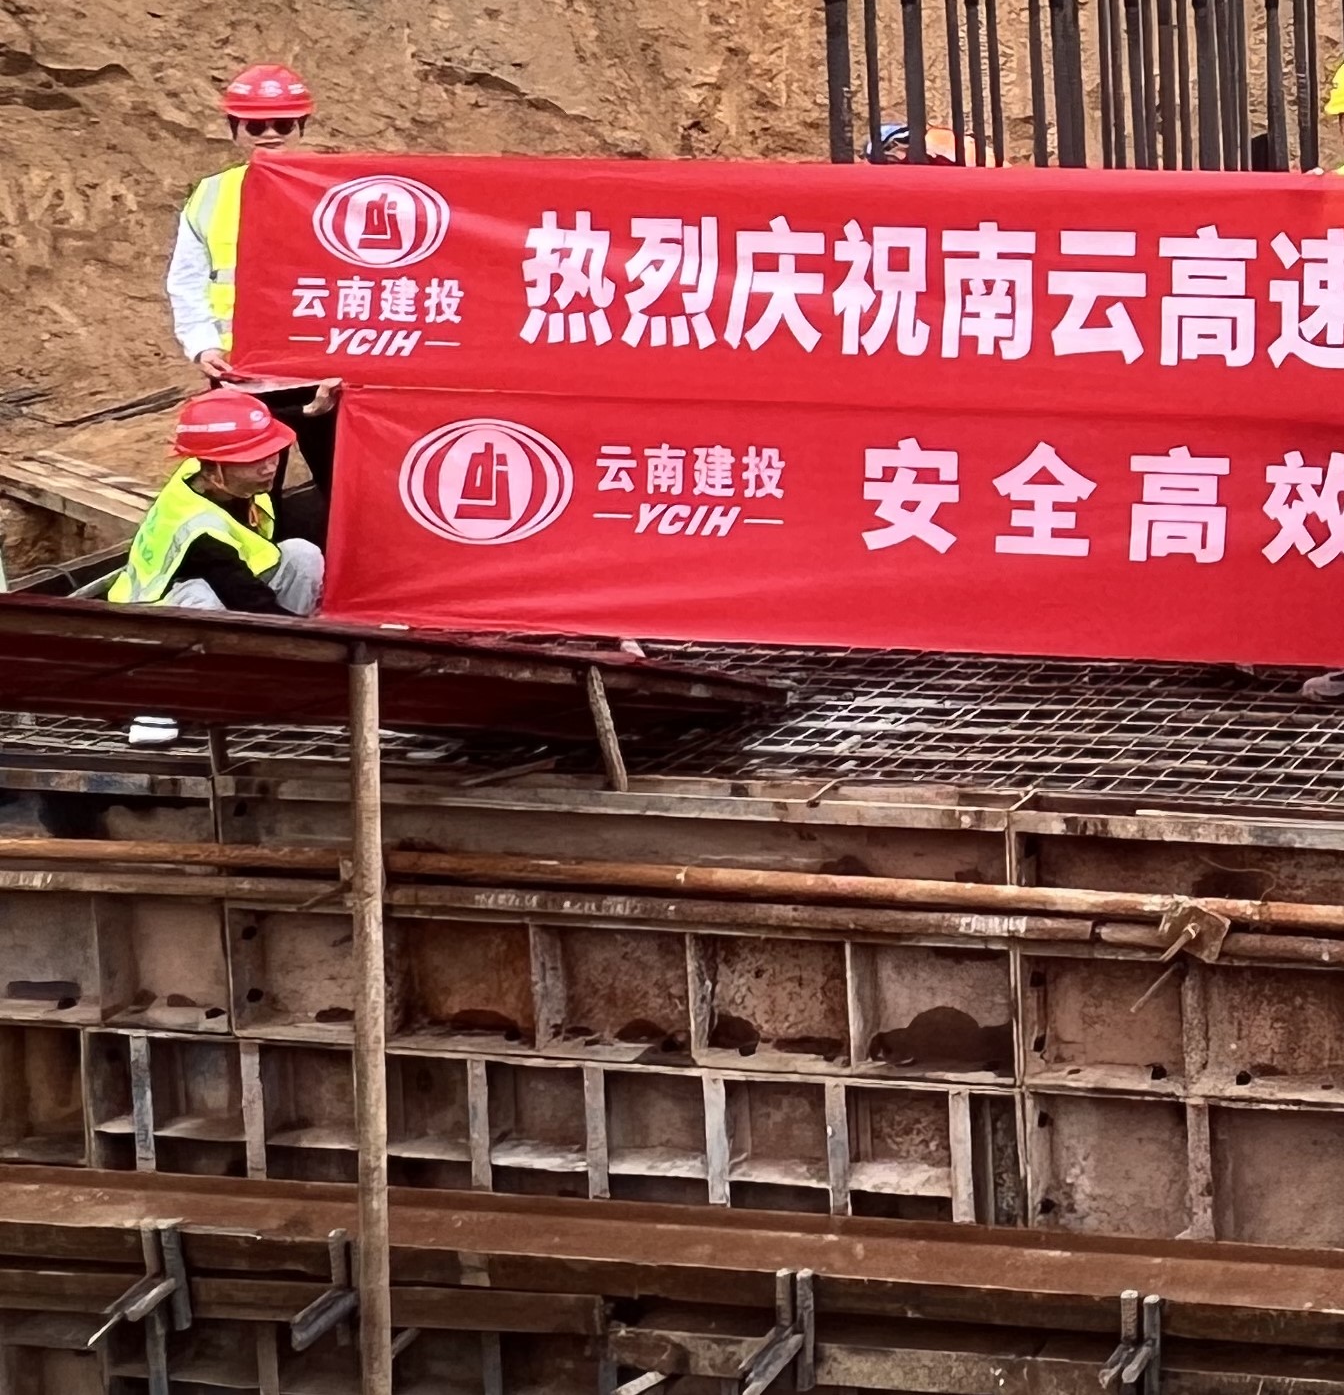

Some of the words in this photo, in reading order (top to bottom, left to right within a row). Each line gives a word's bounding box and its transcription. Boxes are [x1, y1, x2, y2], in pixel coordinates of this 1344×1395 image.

[291, 275, 465, 325] 云南建投
[325, 327, 422, 357] YCIH
[595, 443, 786, 500] 云南建投
[633, 503, 742, 537] YCIH
